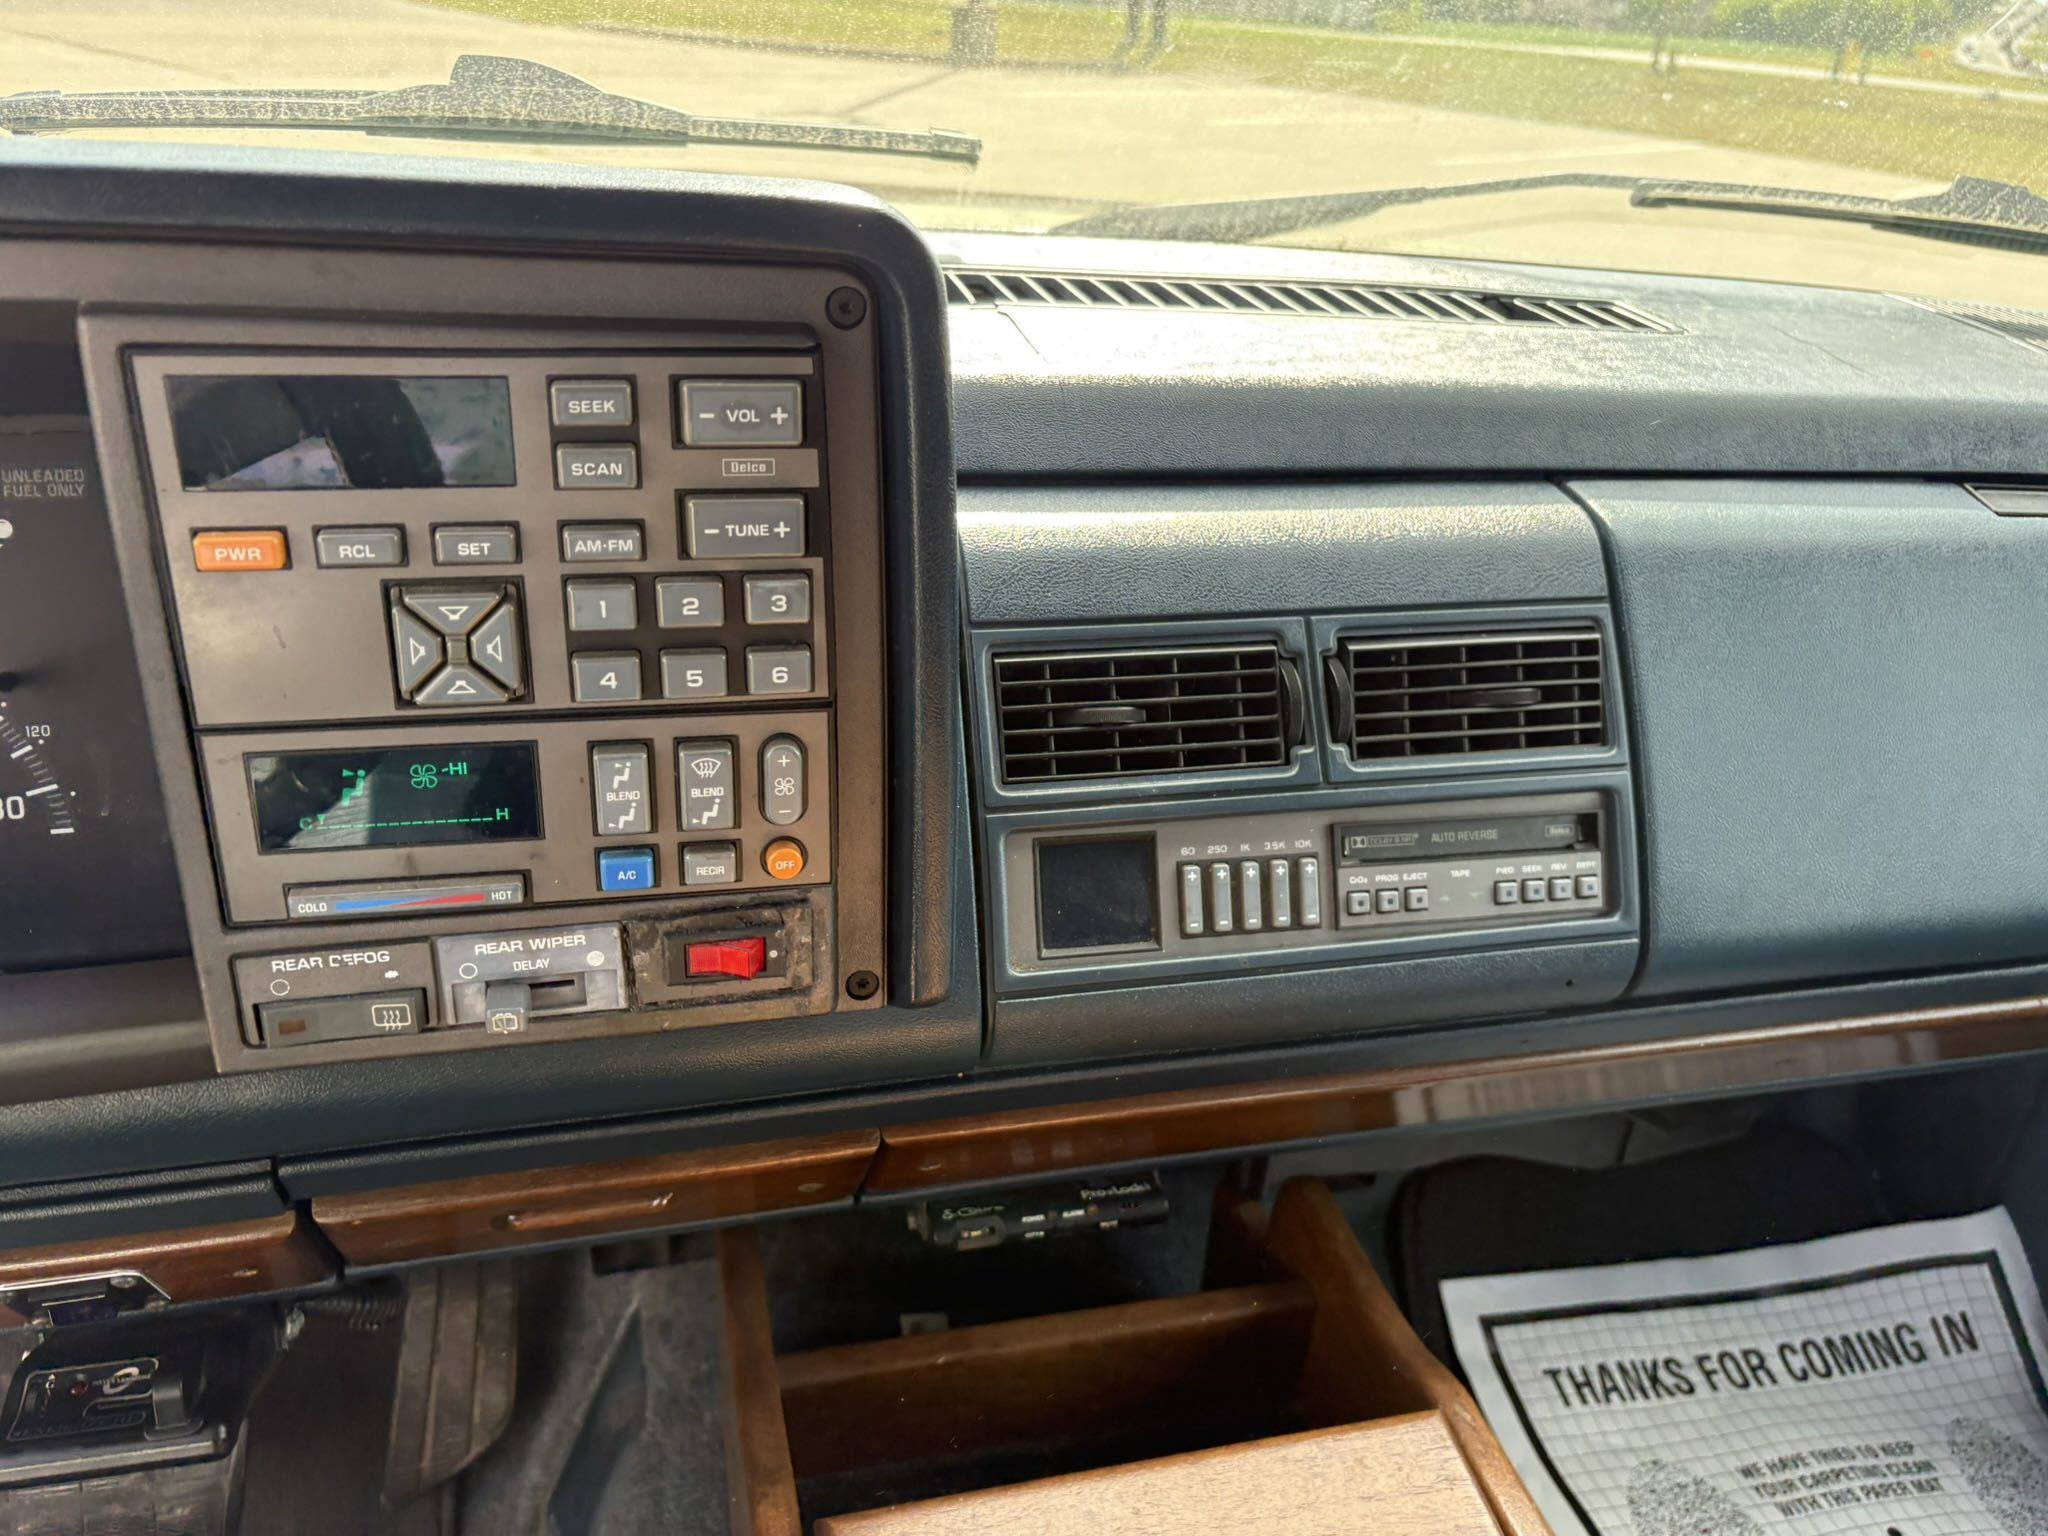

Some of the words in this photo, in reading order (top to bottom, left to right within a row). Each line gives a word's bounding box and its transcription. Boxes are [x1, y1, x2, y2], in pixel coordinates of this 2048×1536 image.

[568, 400, 616, 415] SEEK
[726, 409, 761, 424] VOL
[571, 463, 623, 476] SCAN
[730, 461, 767, 474] Delco
[1, 468, 85, 483] UNLEADED
[3, 483, 42, 497] FUEL
[47, 483, 85, 497] ONLY
[725, 524, 770, 538] TUNE
[214, 547, 263, 562] PWR
[338, 544, 376, 558] RCL
[457, 542, 491, 556] SET
[598, 600, 608, 618] 1
[682, 597, 700, 616] 2
[770, 595, 788, 612] 3
[599, 671, 618, 689] 4
[685, 670, 703, 688] 5
[771, 666, 789, 685] 6
[25, 724, 51, 738] 120
[606, 790, 641, 801] BLEND
[691, 786, 725, 798] BLEND
[495, 807, 510, 821] H
[299, 817, 313, 831] C
[1430, 831, 1456, 843] AUTO
[1457, 829, 1498, 842] REVERSE
[1180, 846, 1196, 856] 60
[1207, 844, 1228, 855] 250
[696, 866, 725, 876] RECIR
[775, 860, 796, 871] OFF
[617, 870, 637, 881] A/C
[1375, 873, 1399, 882] PROG
[1402, 872, 1428, 881] EJECT
[1450, 869, 1471, 878] TAPE
[491, 890, 513, 902] HOT
[298, 902, 328, 913] COLD
[474, 939, 524, 956] REAR
[528, 934, 587, 951] WIPER
[271, 957, 323, 973] REAR
[513, 958, 551, 972] DELAY
[1543, 1356, 1696, 1408] THANKS
[1696, 1348, 1779, 1391] FOR
[1776, 1321, 1929, 1382] COMING
[1929, 1310, 1981, 1357] IN
[1765, 1453, 1811, 1476] HAVE
[1754, 1478, 1800, 1498] YOUR
[1774, 1496, 1824, 1518] WITH
[1860, 1481, 1915, 1500] PAPER
